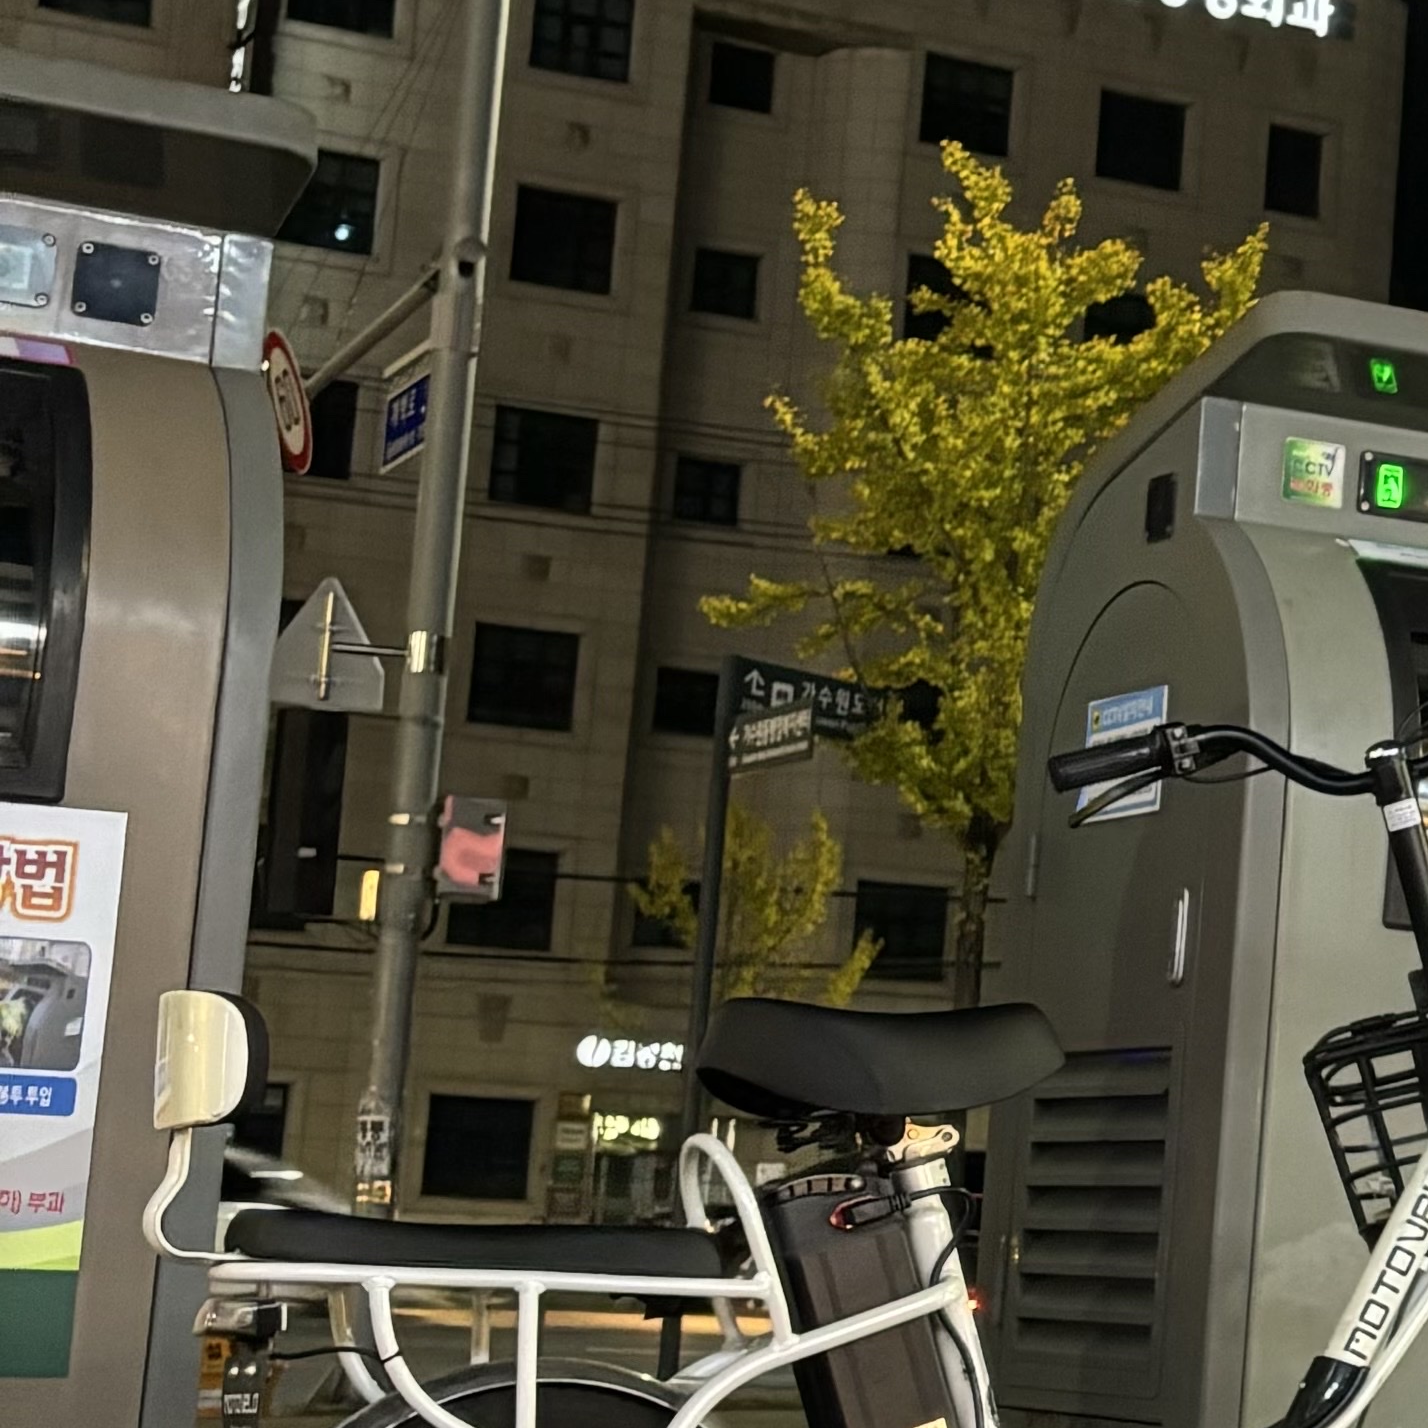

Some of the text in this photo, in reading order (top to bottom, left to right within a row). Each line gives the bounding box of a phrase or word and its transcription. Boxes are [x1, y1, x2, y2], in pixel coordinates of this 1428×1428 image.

[801, 681, 884, 716] 가수원도
[25, 1085, 52, 1107] 투입
[28, 1191, 65, 1214] 부과
